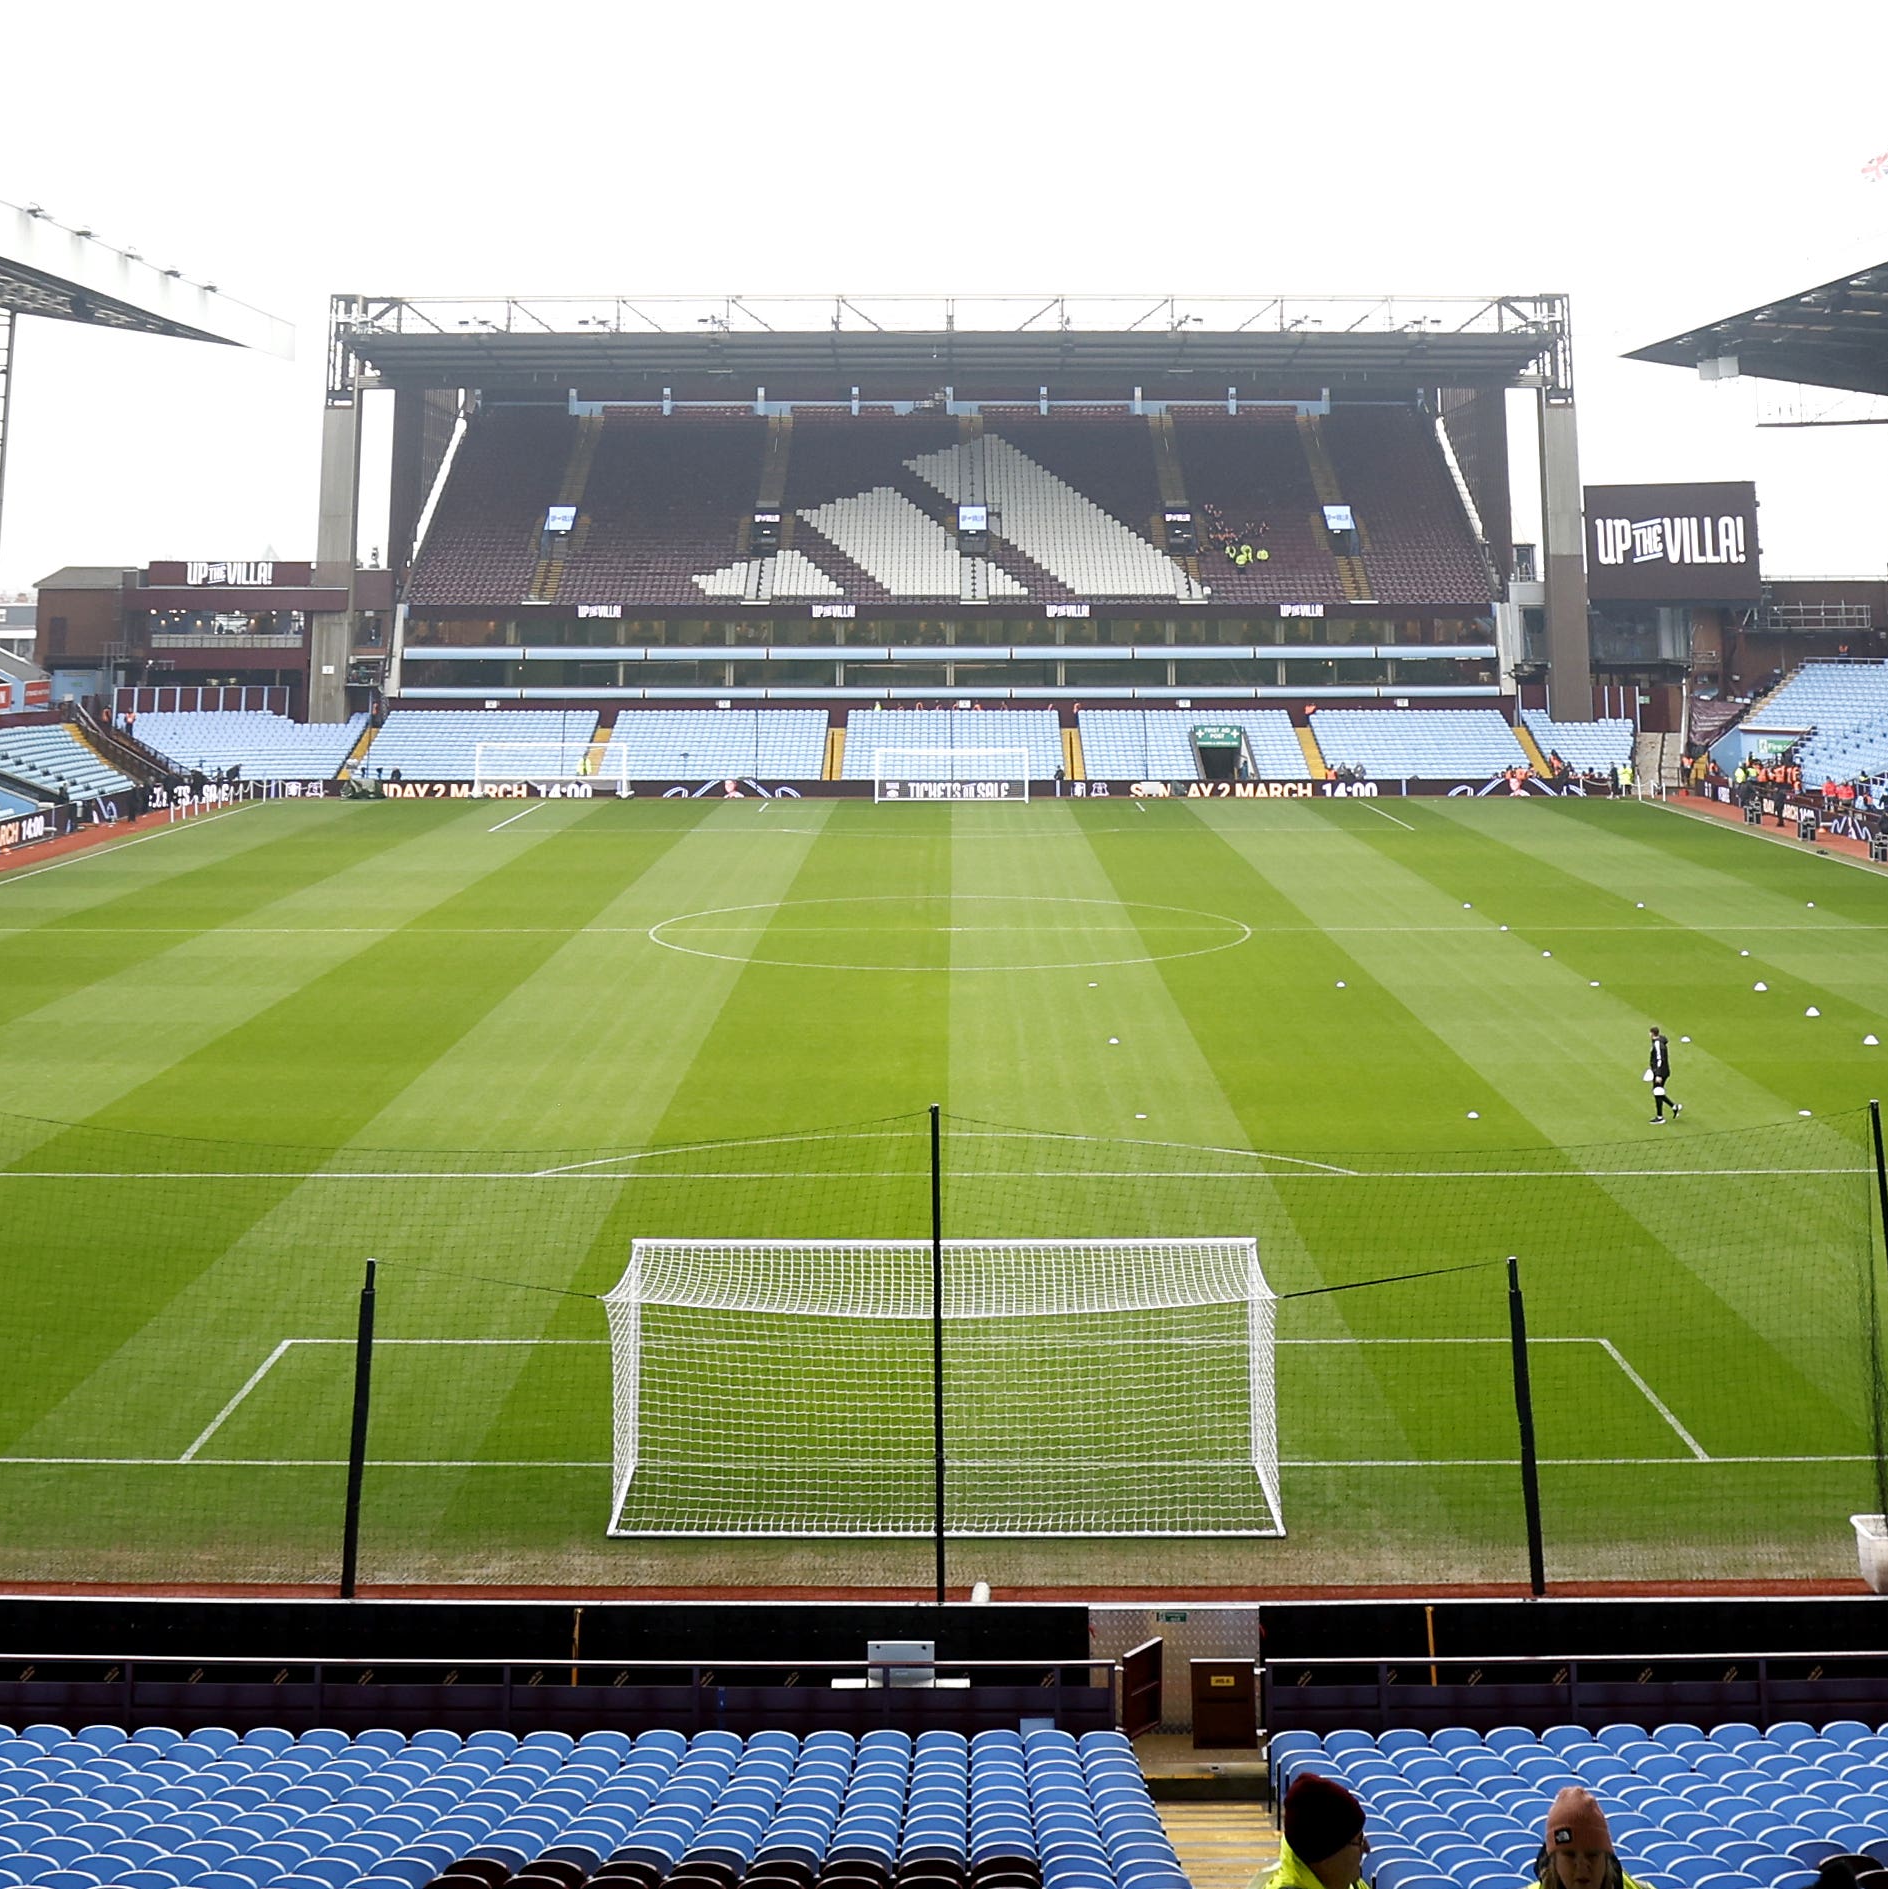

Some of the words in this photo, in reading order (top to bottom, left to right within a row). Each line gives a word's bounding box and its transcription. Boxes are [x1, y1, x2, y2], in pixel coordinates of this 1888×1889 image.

[1595, 518, 1632, 564] UP
[1632, 524, 1663, 557] THE
[1662, 516, 1747, 564] VILLA!
[186, 562, 209, 585] UP
[207, 566, 227, 582] THE
[226, 562, 273, 585] VILLA!
[434, 783, 446, 798] 2
[908, 782, 961, 798] TICKETS
[1217, 783, 1230, 798] 2
[1235, 783, 1313, 798] MARCH
[1322, 783, 1378, 798] 14:00
[21, 815, 45, 841] 14:00
